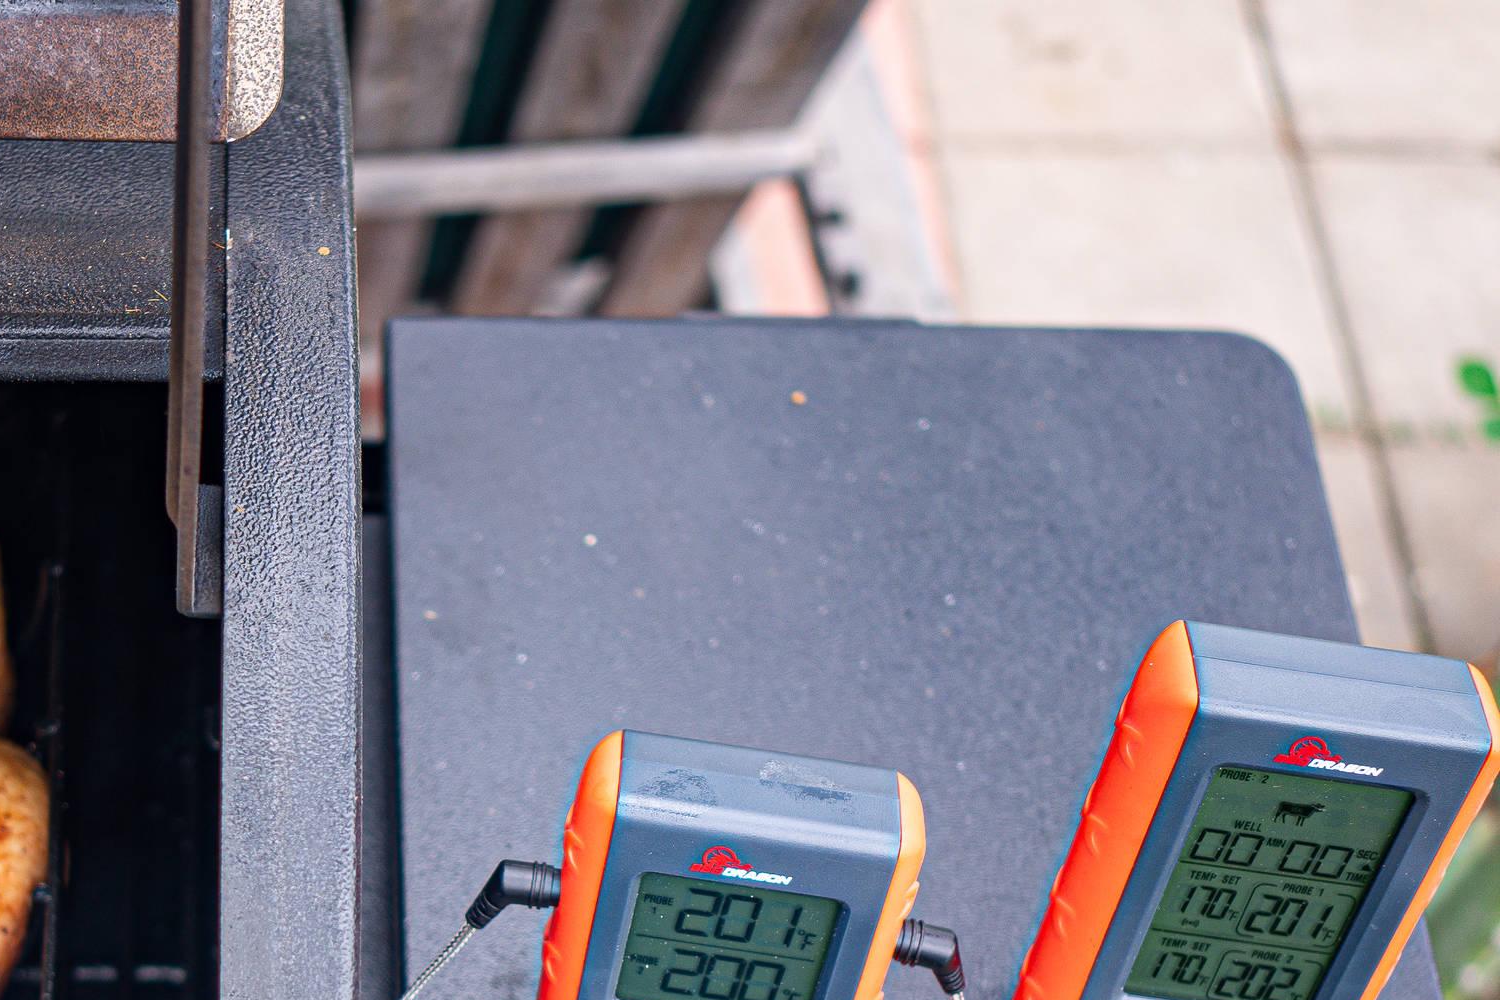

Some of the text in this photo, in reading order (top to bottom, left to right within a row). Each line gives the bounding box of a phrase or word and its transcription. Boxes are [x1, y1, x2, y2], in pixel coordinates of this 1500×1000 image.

[1308, 758, 1384, 777] DRAGON
[1261, 775, 1270, 785] 2
[1233, 819, 1262, 833] WELL
[1265, 837, 1288, 849] MIN
[1355, 849, 1379, 862] SEC
[722, 867, 793, 885] DRAGON
[1189, 870, 1242, 886] TEMP SET
[1344, 871, 1369, 883] TIME
[1282, 883, 1313, 896] PROBE
[643, 893, 675, 907] PROBE
[1160, 936, 1212, 953] TEMP SET
[629, 953, 660, 966] PROBE
[1251, 950, 1282, 962] PROBE
